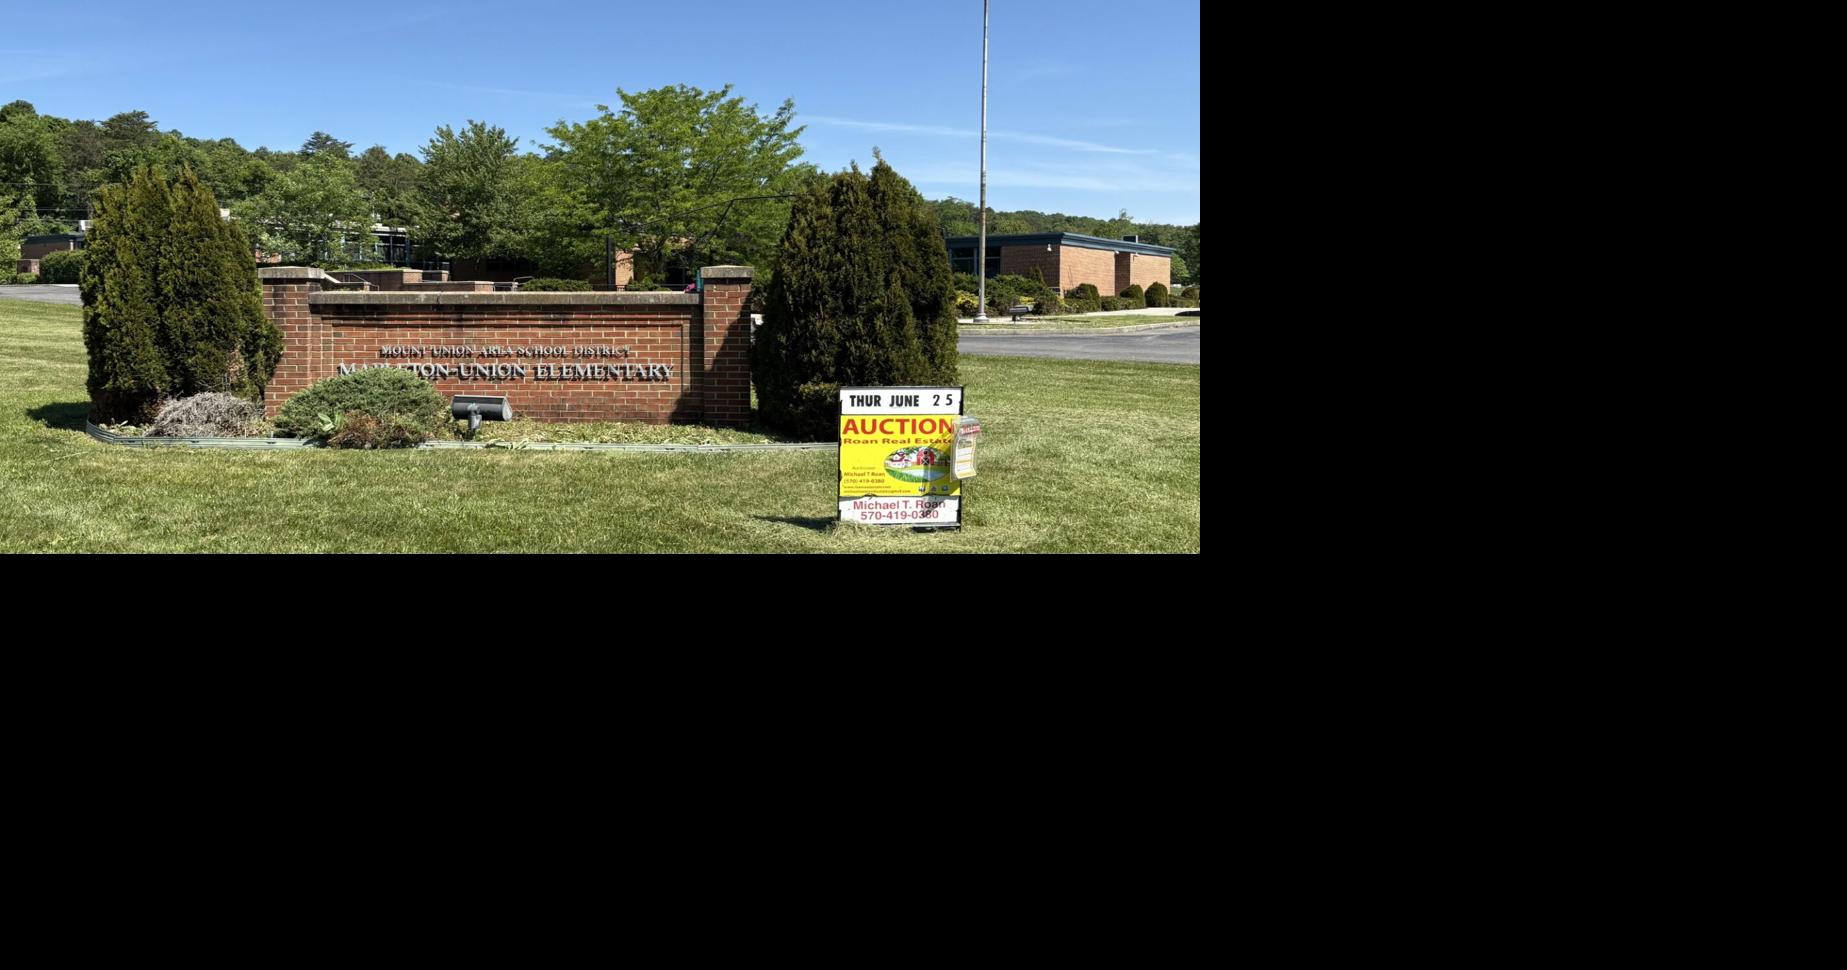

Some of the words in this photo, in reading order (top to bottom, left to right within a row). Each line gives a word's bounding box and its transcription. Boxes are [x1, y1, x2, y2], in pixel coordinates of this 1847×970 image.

[380, 345, 427, 358] MOUNT
[431, 345, 474, 358] UNION
[479, 345, 514, 358] AREA
[517, 345, 568, 358] SCHOOL
[573, 345, 632, 358] DISTRICT
[534, 363, 674, 381] ELEMENTARY
[849, 394, 882, 407] THUR
[889, 394, 920, 407] JUNE
[842, 418, 954, 435] AUCTION
[843, 437, 878, 445] Roan
[882, 437, 911, 445] Real
[853, 500, 900, 510] Michael
[902, 500, 912, 509] T.
[915, 500, 946, 509] Roan
[860, 510, 939, 520] 570-419-0380
